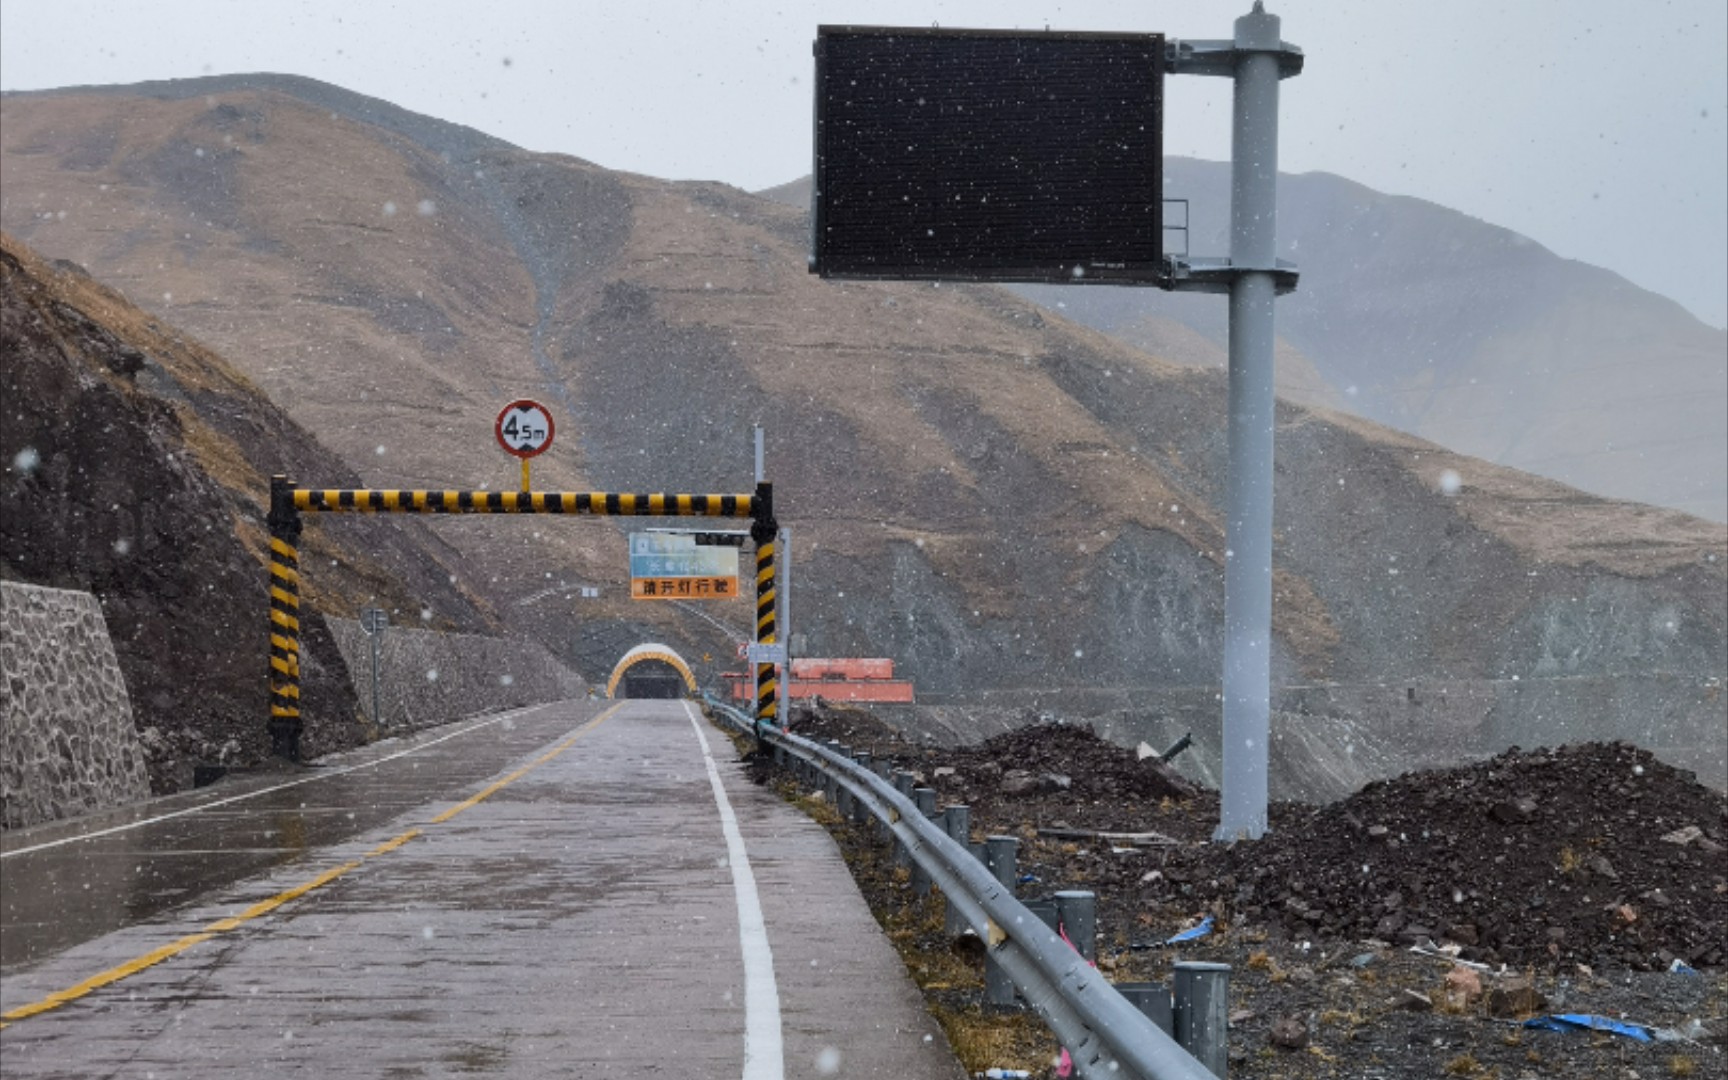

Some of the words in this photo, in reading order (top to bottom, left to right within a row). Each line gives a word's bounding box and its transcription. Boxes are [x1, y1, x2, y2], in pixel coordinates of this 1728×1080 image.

[643, 578, 729, 596] 请开灯行驶
